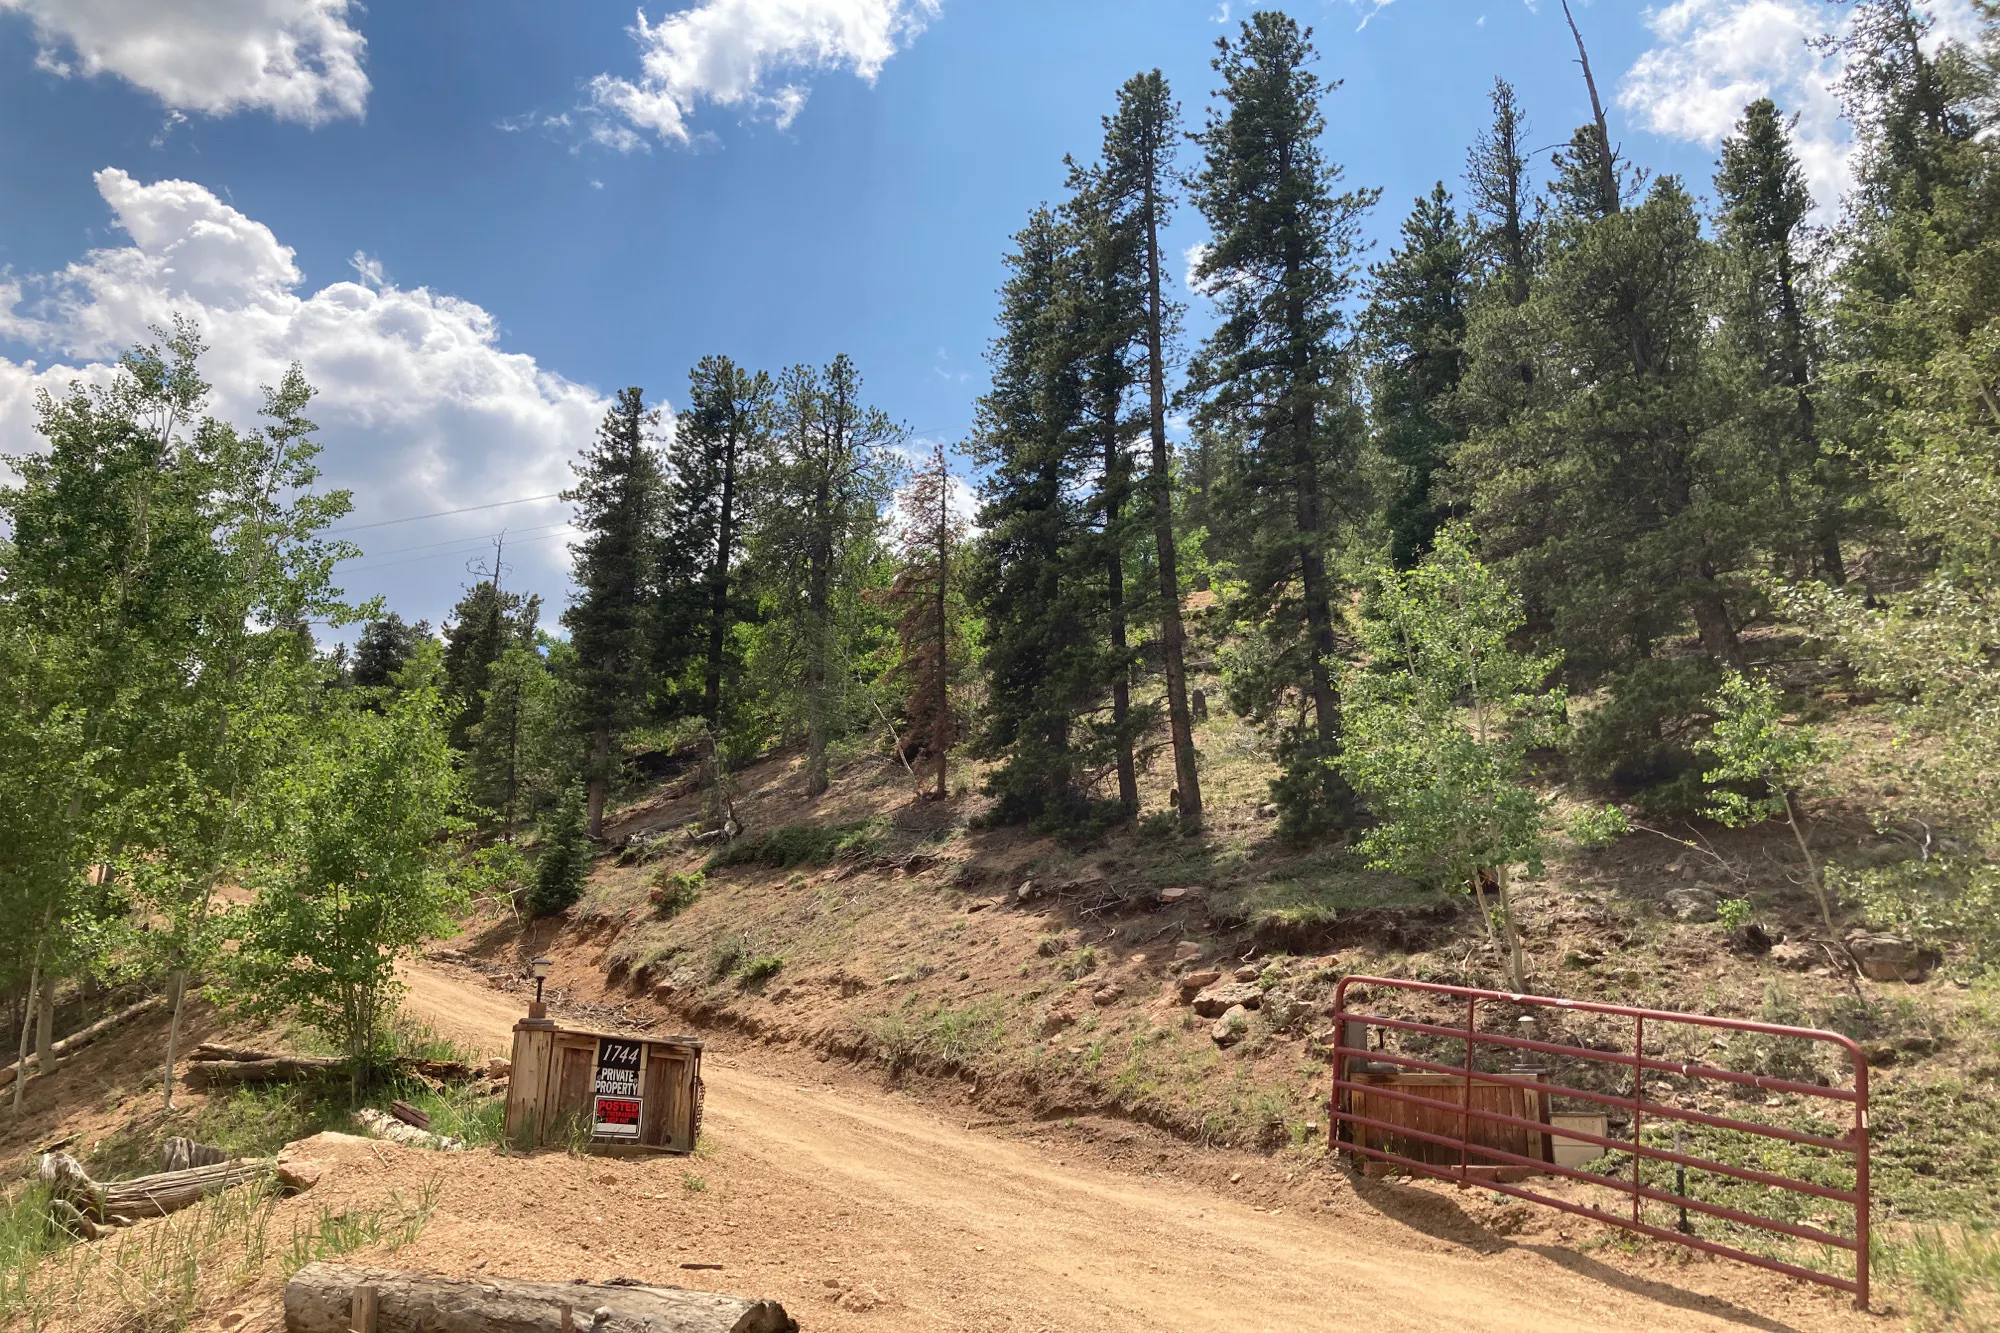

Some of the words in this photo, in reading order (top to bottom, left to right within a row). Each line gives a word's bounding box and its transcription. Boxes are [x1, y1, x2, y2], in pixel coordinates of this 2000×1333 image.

[603, 1044, 639, 1064] 1744
[601, 1068, 635, 1082] PRIVATE
[595, 1081, 638, 1095] PROPERTY
[598, 1101, 638, 1112] POSTED
